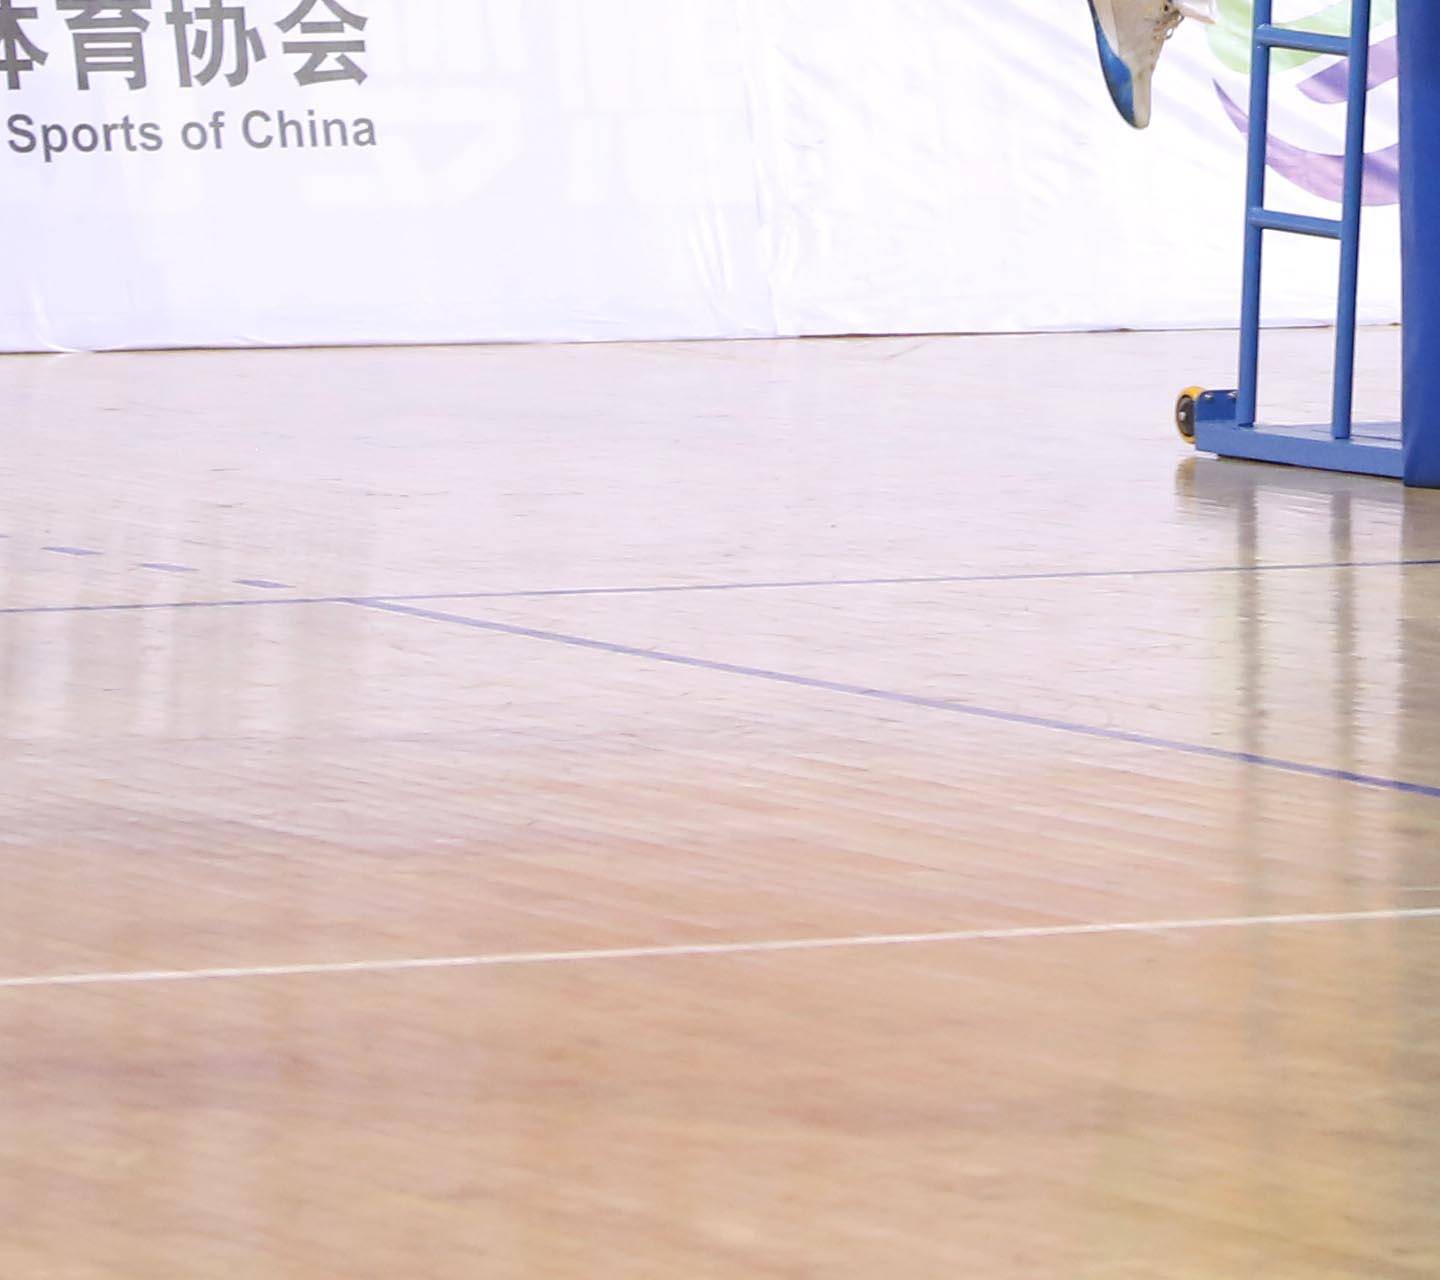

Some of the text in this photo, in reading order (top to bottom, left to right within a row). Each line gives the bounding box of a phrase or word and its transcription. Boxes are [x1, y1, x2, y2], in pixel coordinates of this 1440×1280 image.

[7, 113, 164, 163] Sports
[179, 109, 226, 151] of
[241, 108, 377, 150] China
